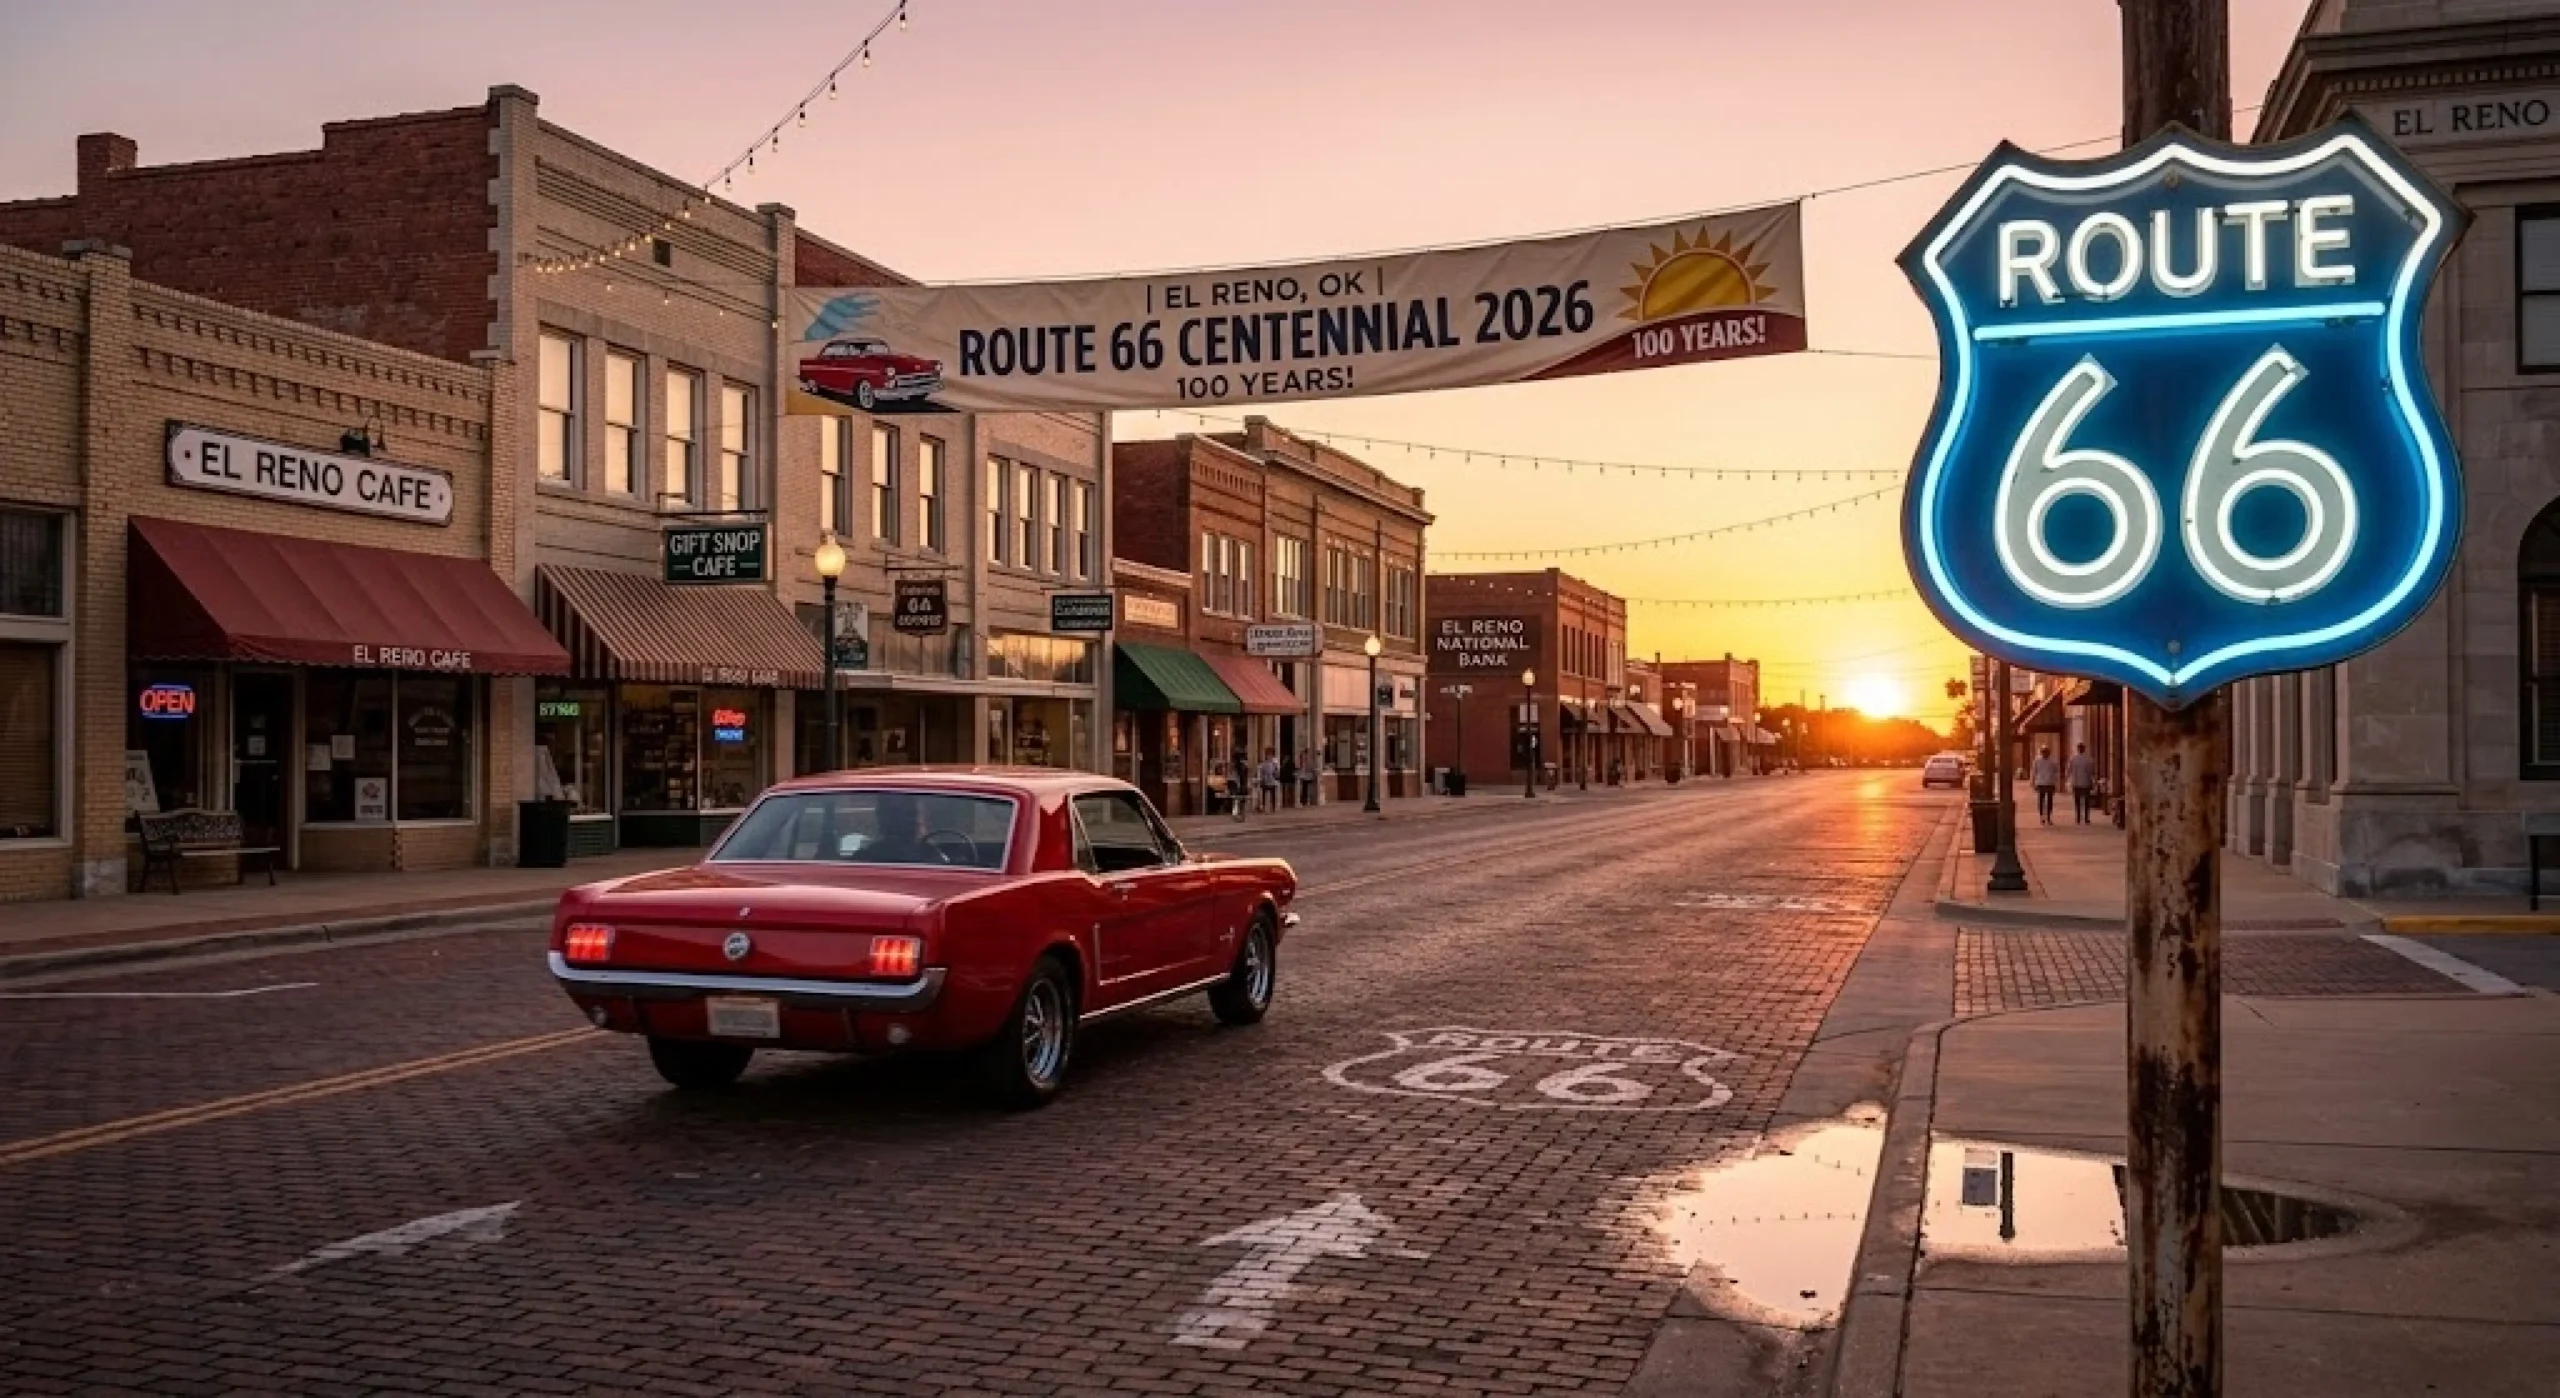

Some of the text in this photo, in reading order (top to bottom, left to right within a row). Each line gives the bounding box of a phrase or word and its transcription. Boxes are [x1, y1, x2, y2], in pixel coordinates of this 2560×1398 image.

[2394, 99, 2550, 136] EL RENO
[1997, 194, 2355, 309] ROUTE
[1165, 270, 1365, 309] EL RENO, OK
[959, 279, 1594, 377] ROUTE 66 CENTENNIAL 2026
[1631, 315, 1766, 359] 100 YEARS!
[1176, 365, 1355, 400] 100 YEARS!
[201, 441, 431, 510] EL RENO CAFE
[1994, 341, 2359, 609] 66
[692, 555, 736, 576] CAFE
[1436, 636, 1530, 651] NATIONAL
[1441, 619, 1524, 635] EL RENO
[353, 644, 376, 664] EL
[1459, 652, 1509, 668] BANK
[139, 689, 196, 714] OPEN
[1426, 1032, 1688, 1063] ROUTE
[1392, 1052, 1654, 1101] 66
